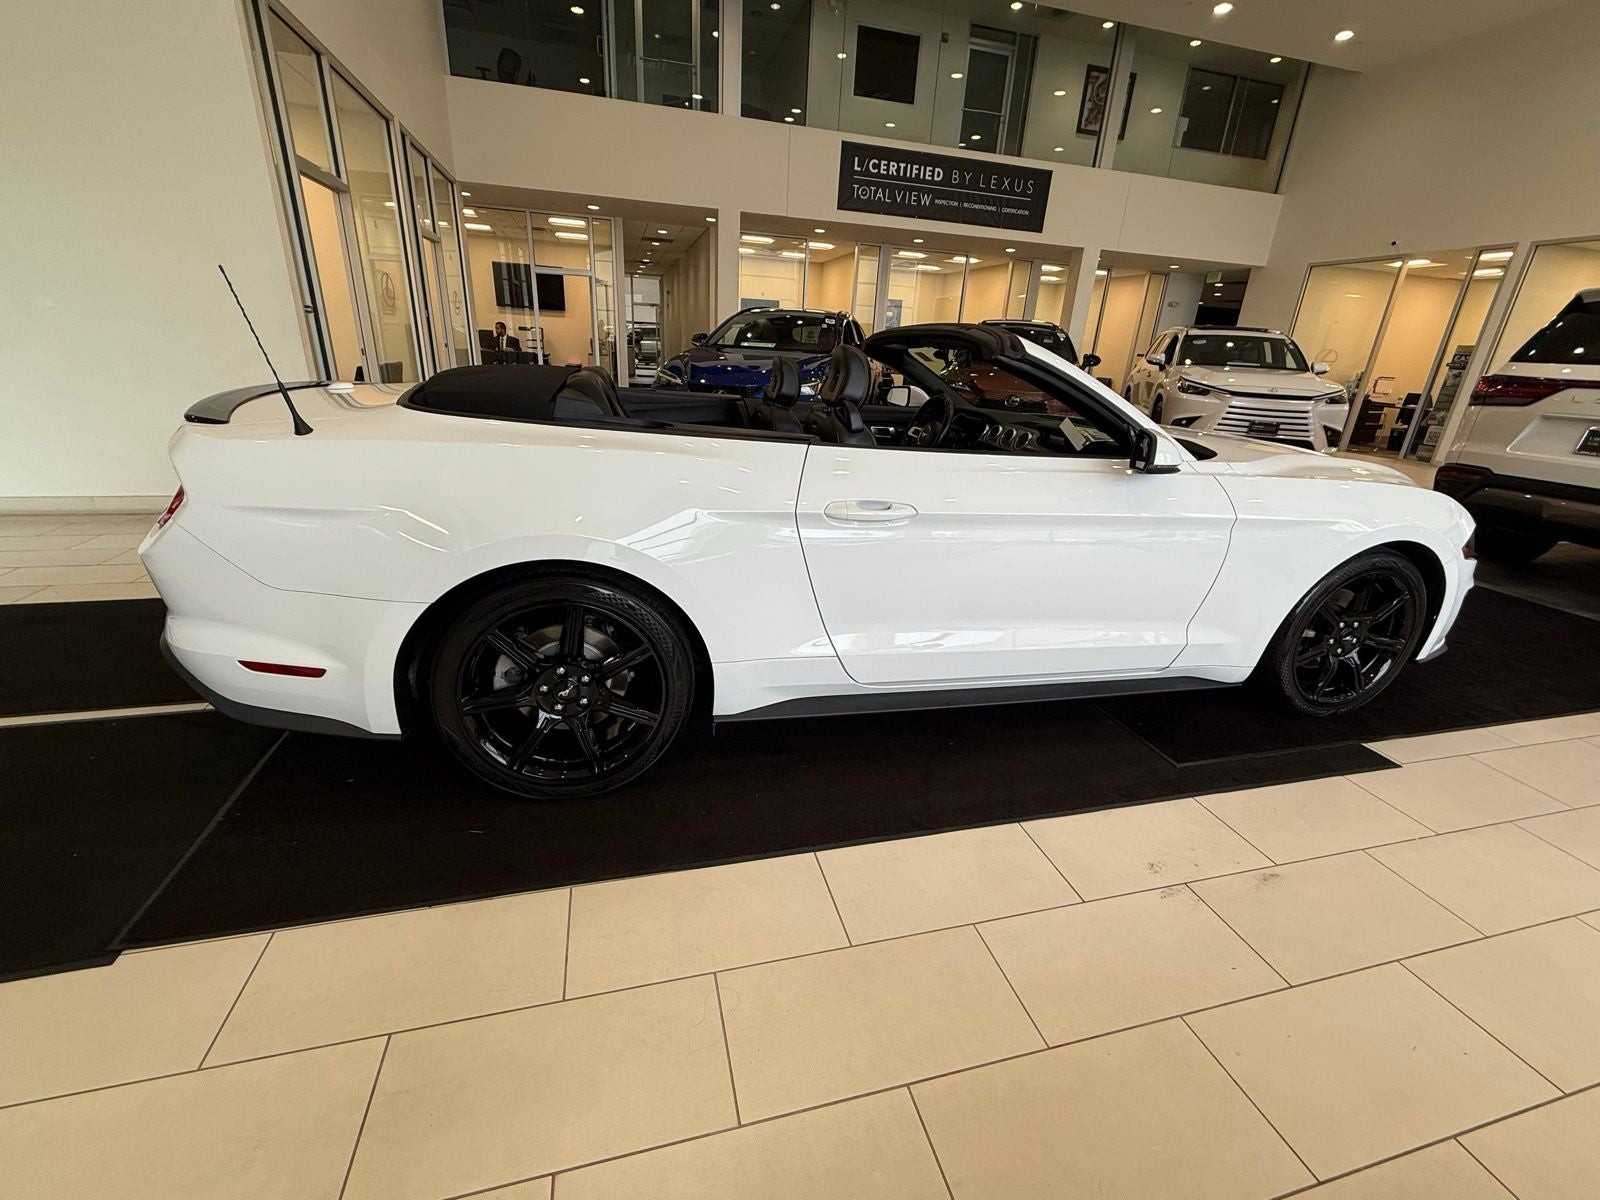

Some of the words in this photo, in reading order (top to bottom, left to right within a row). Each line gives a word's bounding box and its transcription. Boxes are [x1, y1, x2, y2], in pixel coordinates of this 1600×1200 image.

[854, 156, 944, 182] L/CERTIFIED
[952, 169, 973, 185] BY
[980, 173, 1034, 194] LEXUS
[853, 184, 891, 202] TOTAL
[895, 189, 932, 207] VIEW
[935, 199, 958, 207] INSPECTION
[963, 202, 997, 212] RECONDITIONING
[1001, 207, 1029, 215] CERTIFICATION
